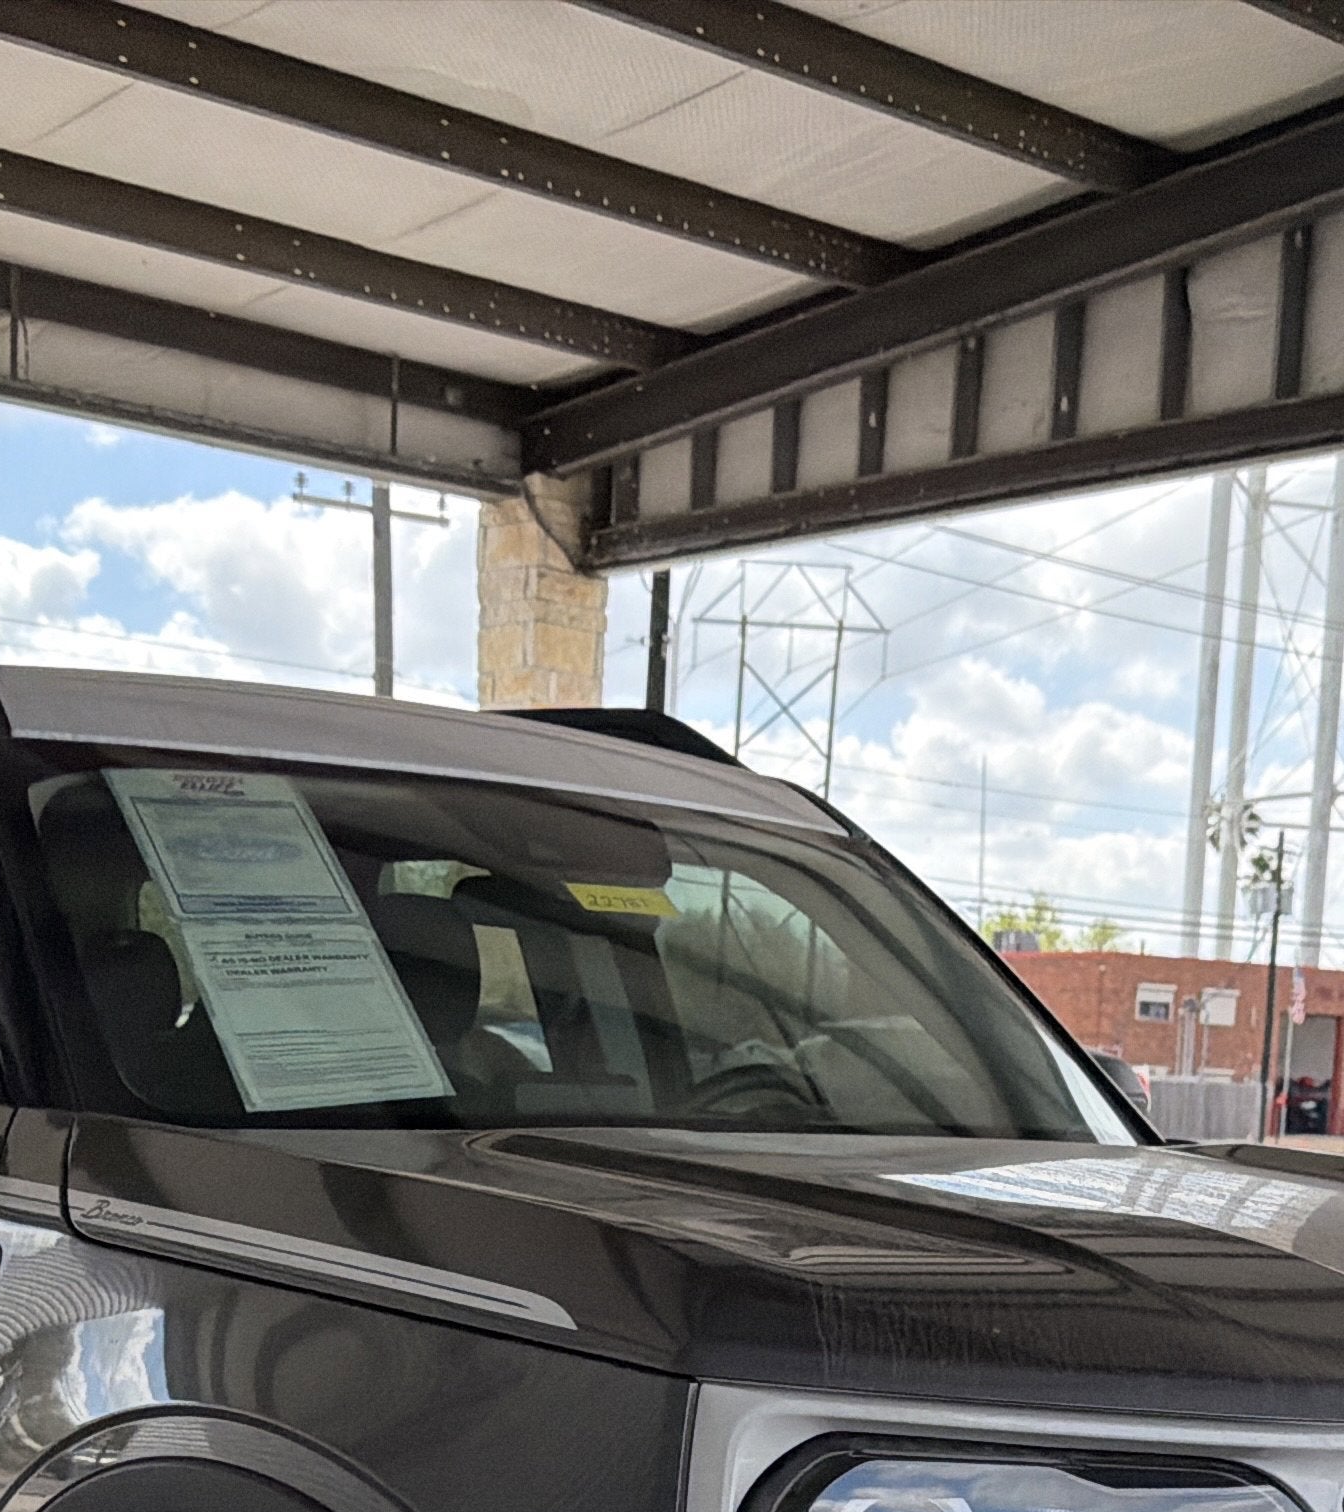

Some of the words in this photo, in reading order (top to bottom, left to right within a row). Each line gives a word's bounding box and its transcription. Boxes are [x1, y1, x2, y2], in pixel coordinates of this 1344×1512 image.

[312, 953, 370, 961] WARRANTY
[225, 968, 268, 976] DEALER
[270, 966, 327, 975] WARRANTY
